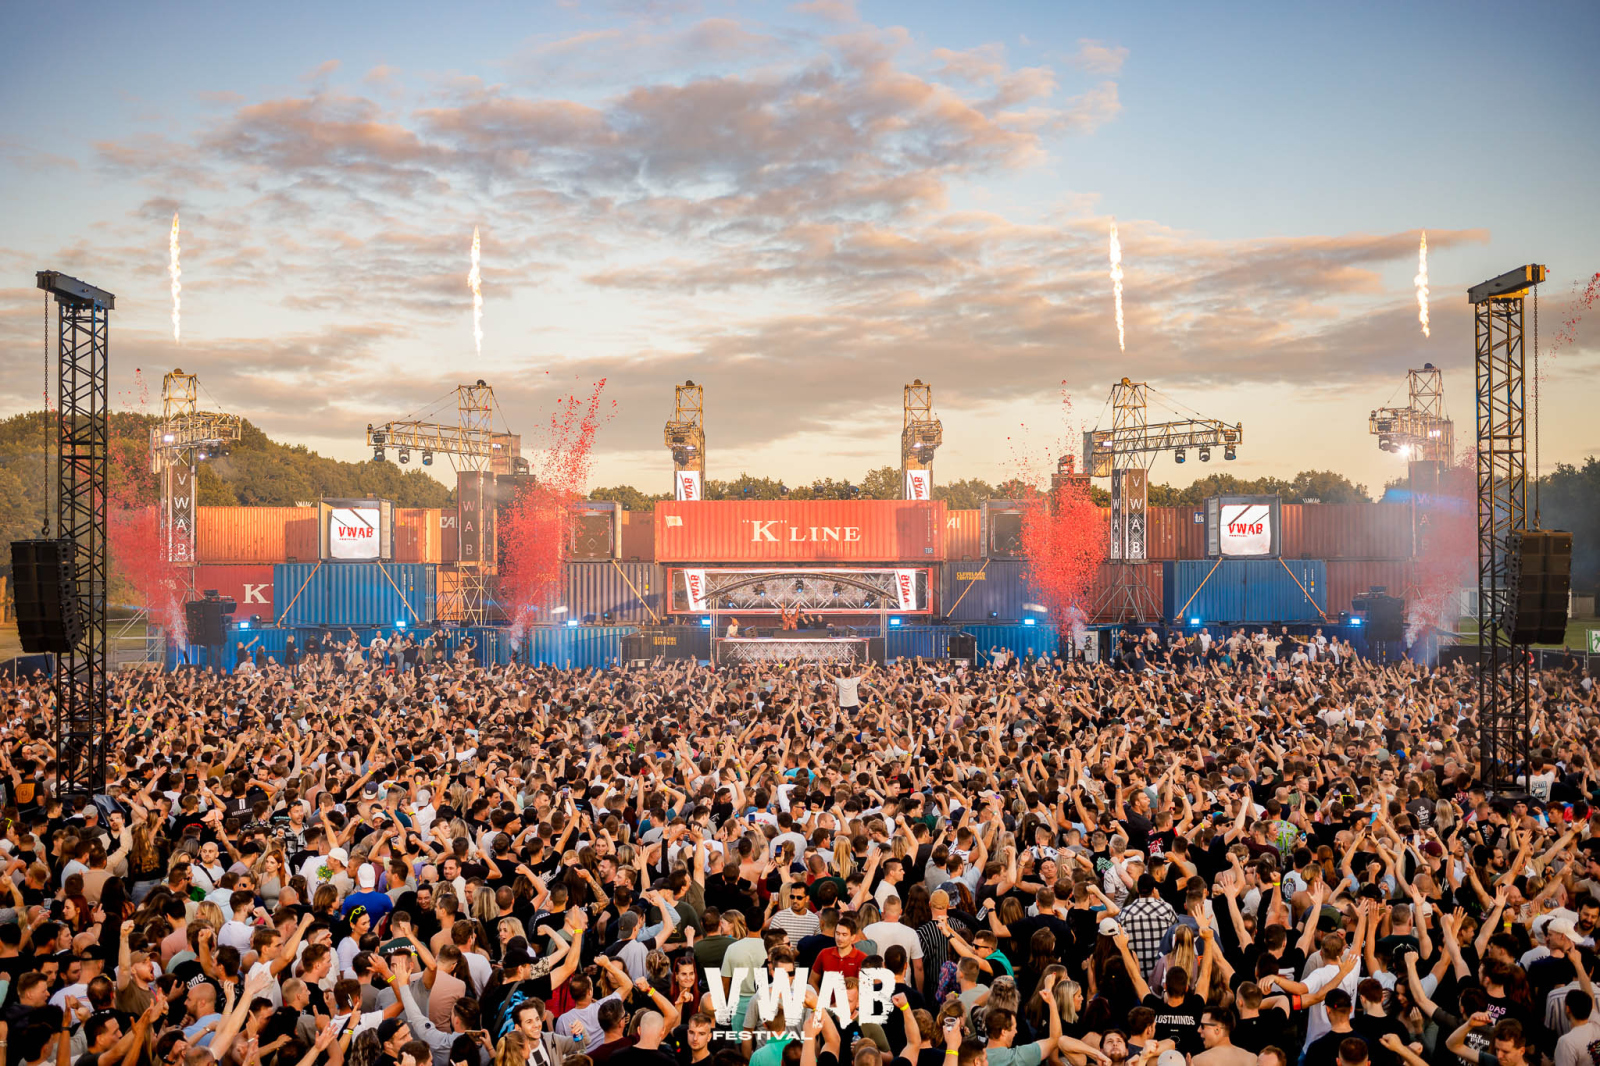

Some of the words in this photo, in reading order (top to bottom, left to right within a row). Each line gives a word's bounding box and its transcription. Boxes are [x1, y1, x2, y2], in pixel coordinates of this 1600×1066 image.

[684, 477, 693, 499] WAB
[914, 476, 923, 498] WAB
[174, 473, 190, 556] VWAB
[946, 517, 960, 529] AI
[1112, 475, 1121, 554] VWAB
[1129, 475, 1143, 554] VWAB
[338, 526, 374, 538] VWAB
[788, 526, 860, 541] LINE
[1228, 523, 1263, 535] VWAB
[690, 574, 700, 603] VWAB
[900, 574, 910, 603] VWAB
